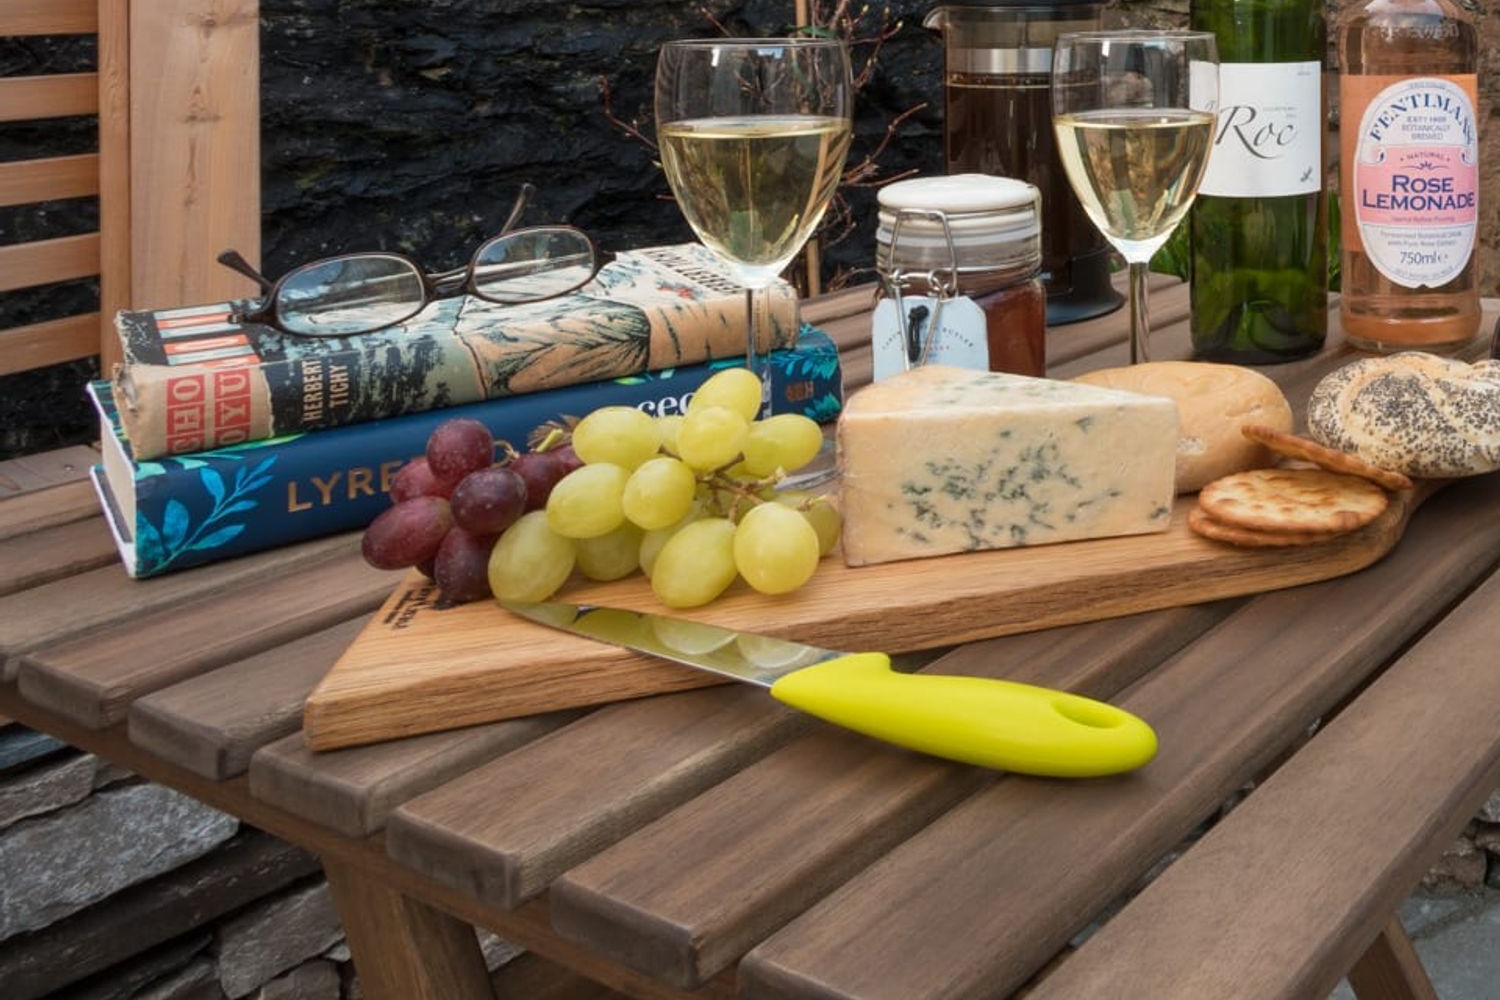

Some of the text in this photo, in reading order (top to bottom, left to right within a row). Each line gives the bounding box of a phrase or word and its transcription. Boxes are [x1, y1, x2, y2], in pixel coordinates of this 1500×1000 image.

[1215, 104, 1297, 159] Roc
[1362, 188, 1475, 211] LEMONADE
[1391, 174, 1454, 193] ROSE
[1400, 251, 1437, 265] 750ml
[301, 360, 323, 421] HERBERT
[328, 365, 350, 408] TICHY
[287, 457, 424, 512] LYRE
